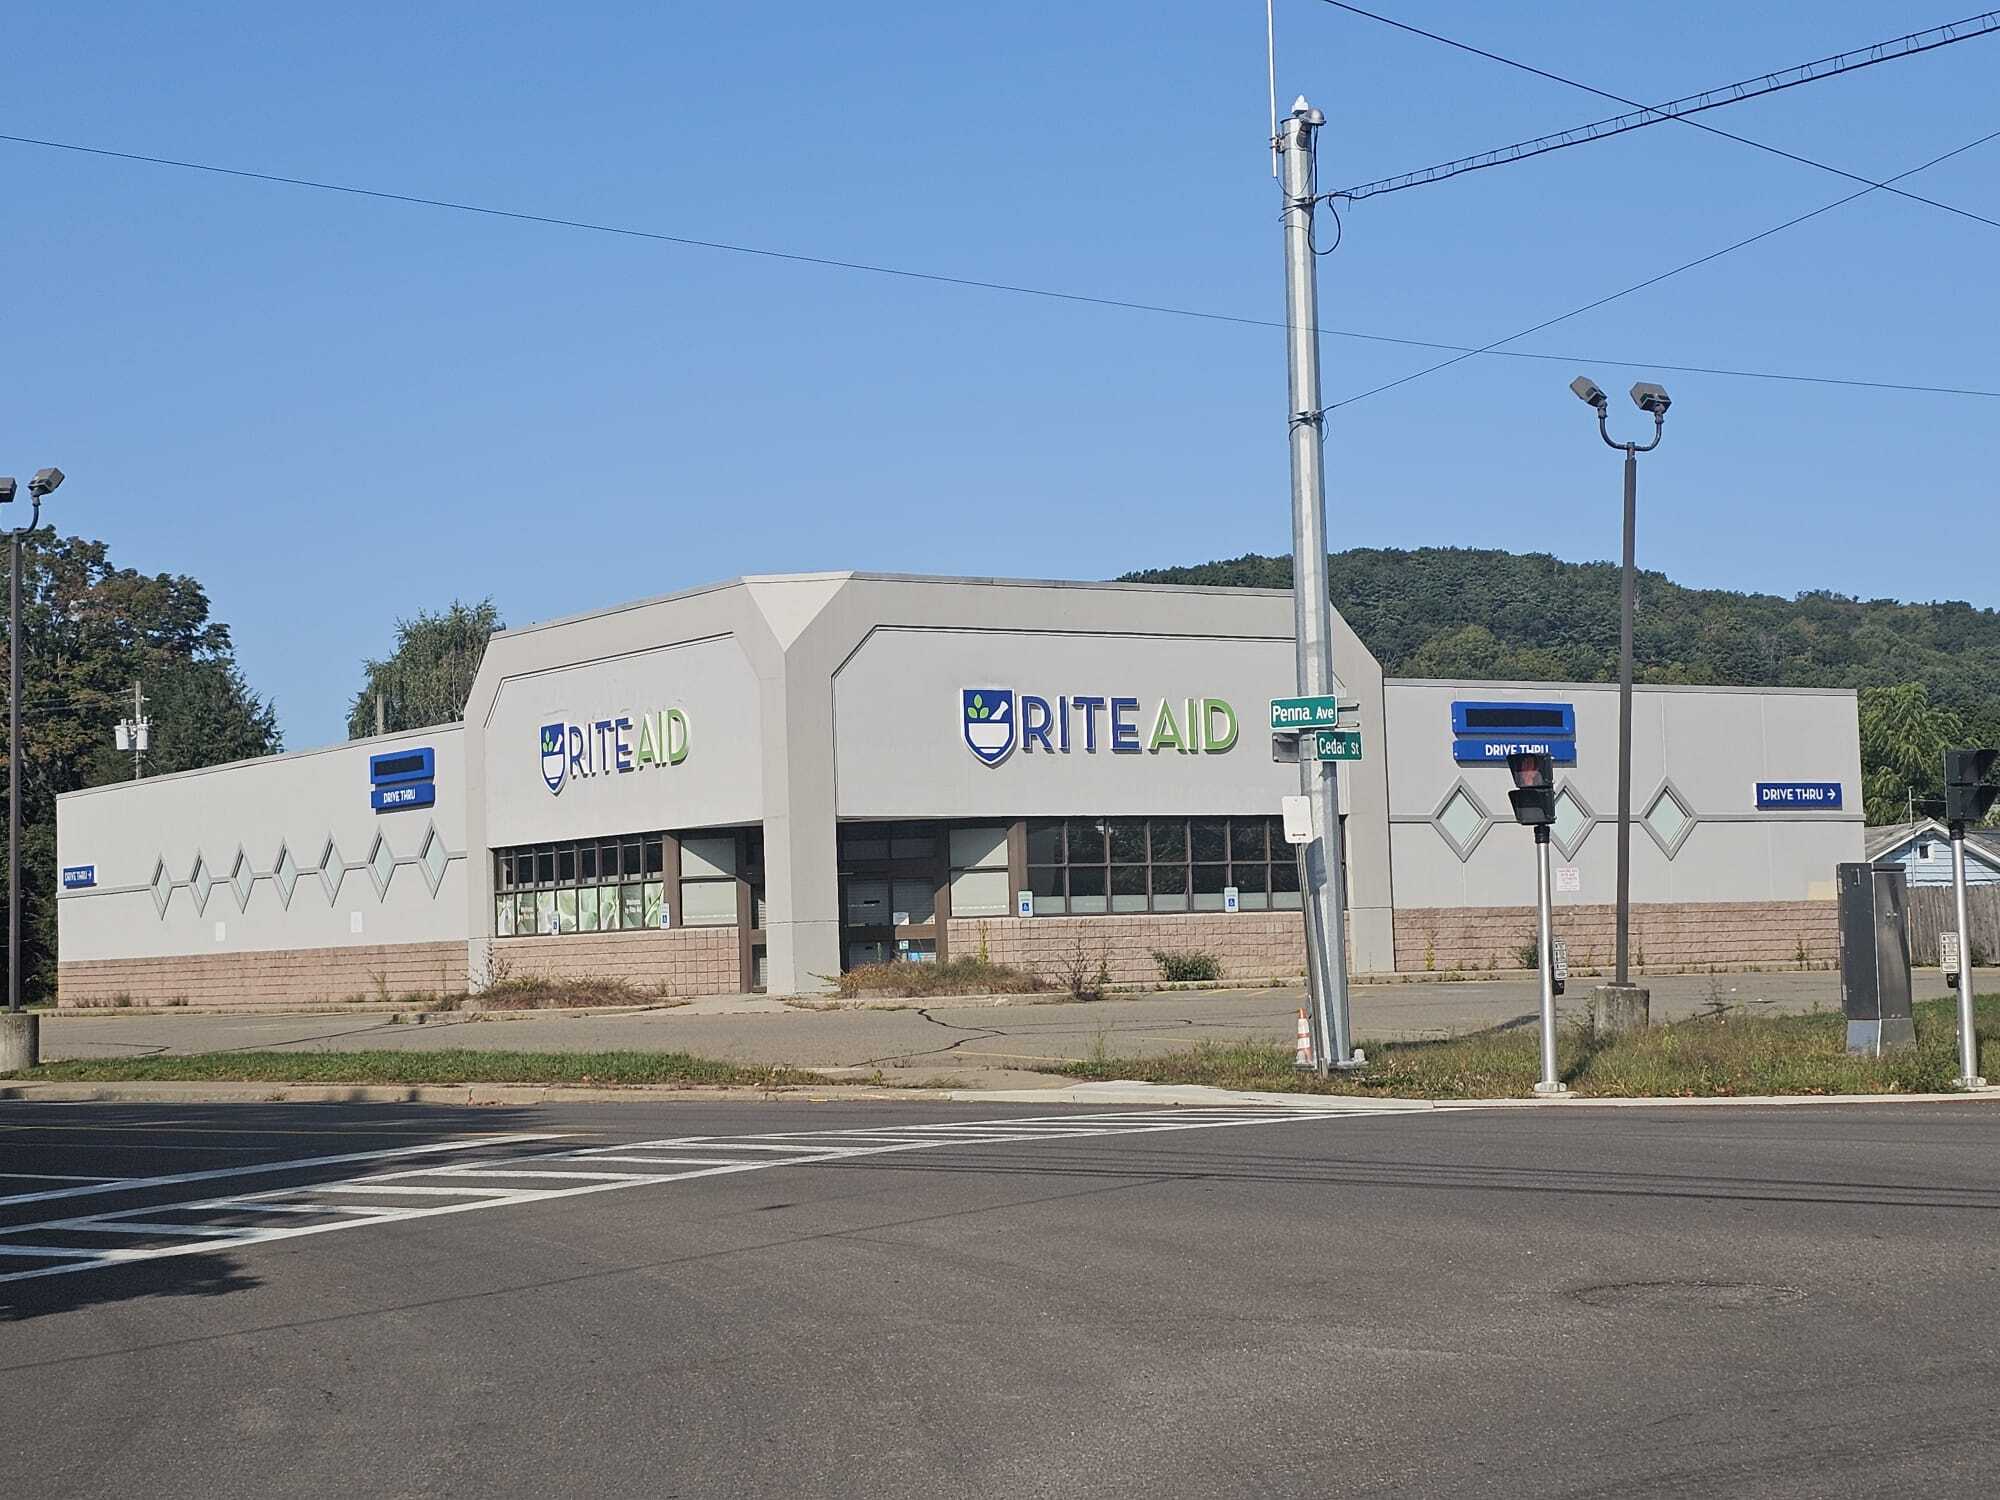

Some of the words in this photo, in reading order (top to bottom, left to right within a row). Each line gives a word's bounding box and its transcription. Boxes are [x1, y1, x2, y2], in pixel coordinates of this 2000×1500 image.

[1272, 705, 1312, 722] Penna.
[1316, 706, 1334, 720] Ave
[1019, 695, 1142, 753] RITE
[1147, 697, 1238, 754] AID
[568, 717, 634, 779] RITE
[636, 707, 688, 771] AID
[1319, 737, 1346, 755] Cedar
[1485, 744, 1517, 756] DRIVE
[383, 791, 399, 803] DRIVE
[400, 788, 416, 801] THRU
[1762, 788, 1794, 801] DRIVE
[1795, 788, 1823, 801] THRU
